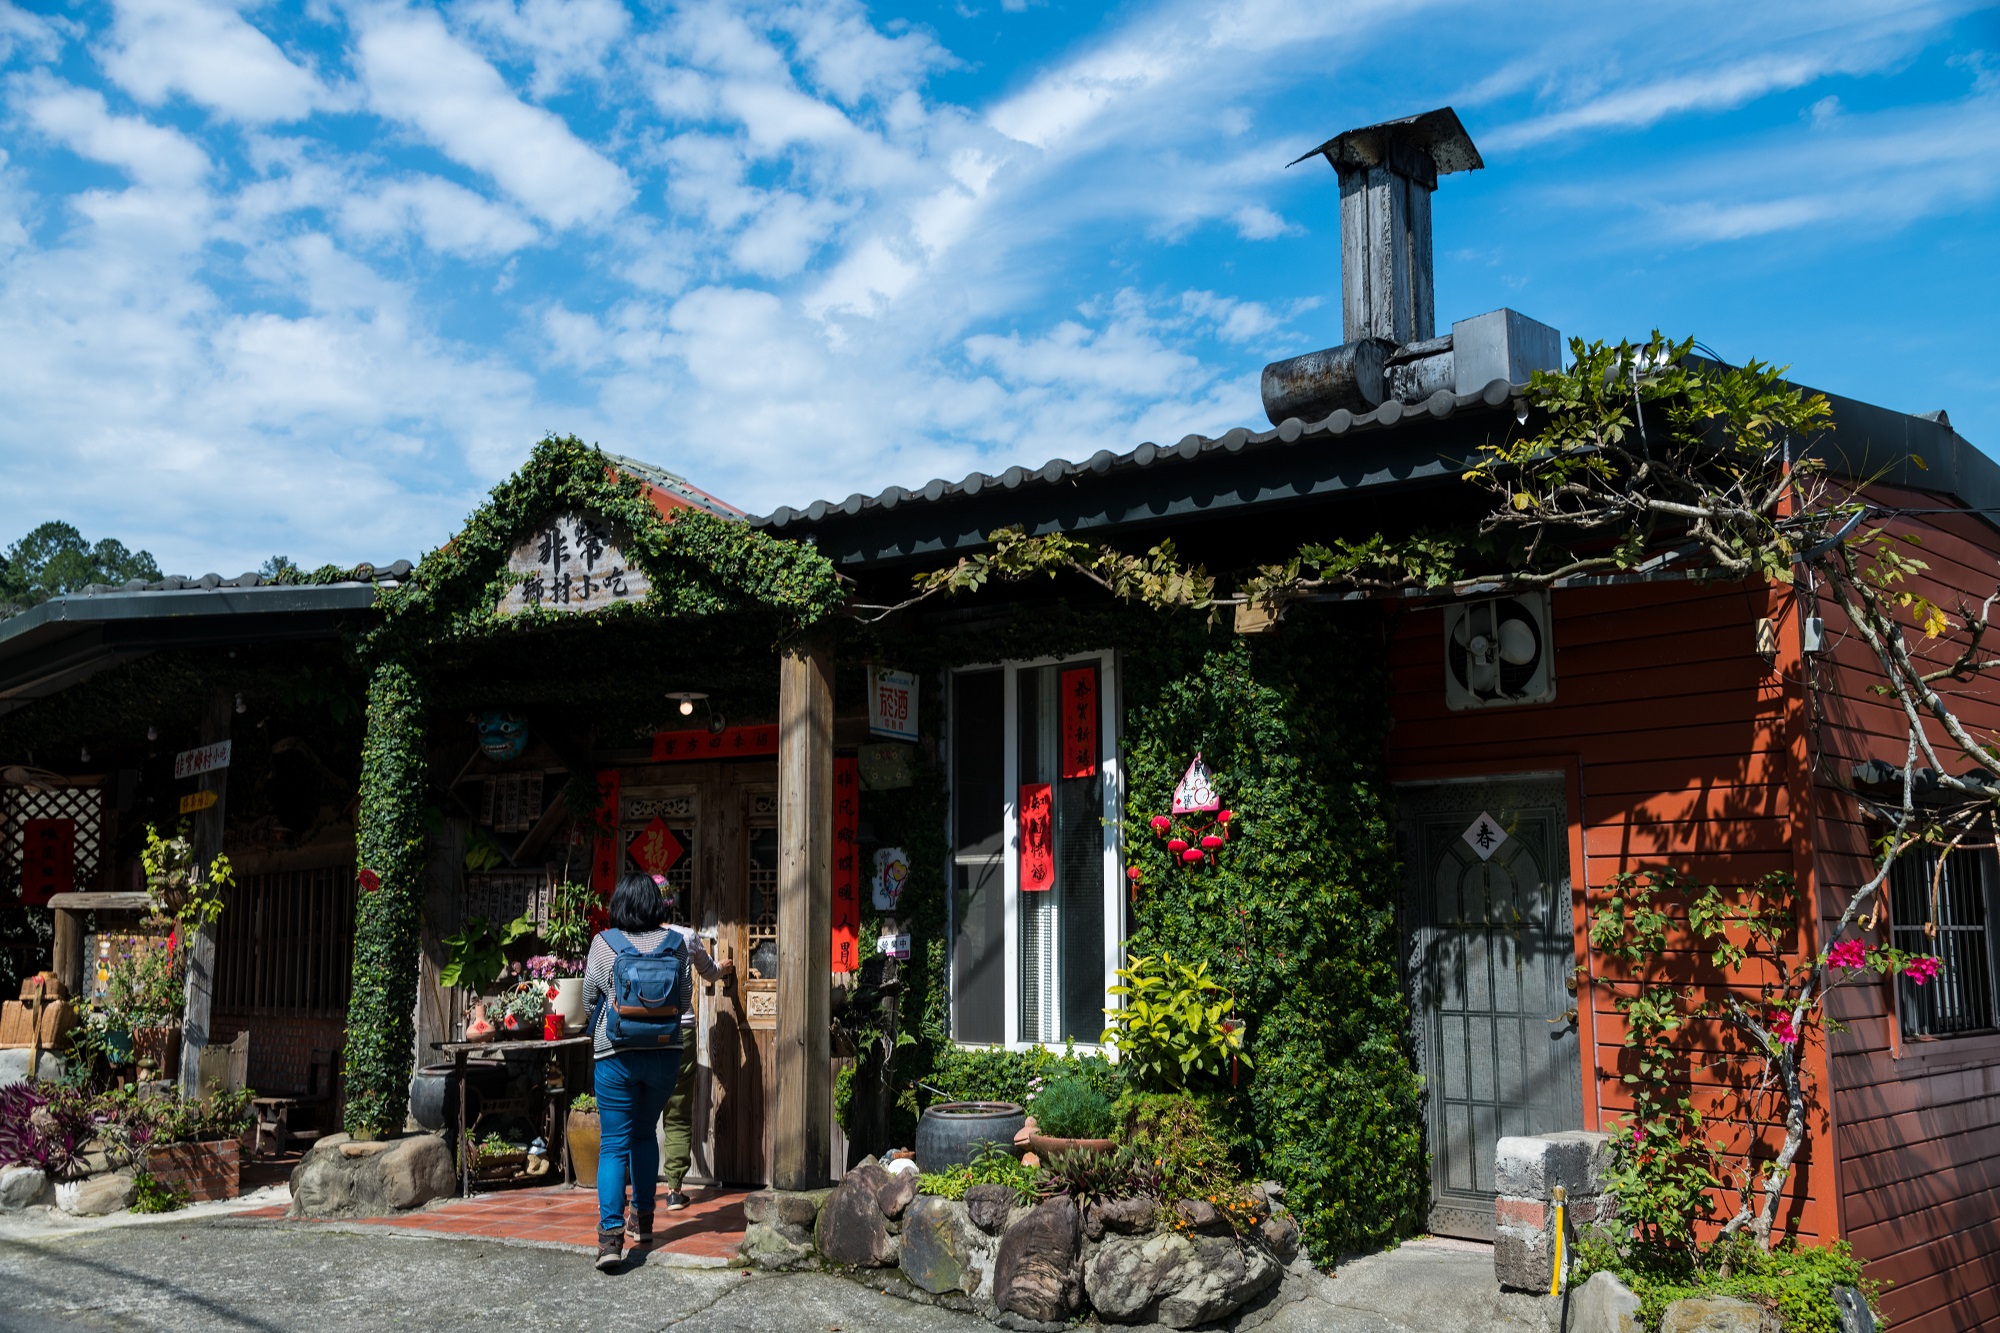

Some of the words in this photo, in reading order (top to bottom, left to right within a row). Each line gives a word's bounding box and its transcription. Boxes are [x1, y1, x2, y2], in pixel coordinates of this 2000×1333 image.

[538, 519, 607, 576] 非常
[522, 566, 629, 605] 鄉村小吃
[879, 686, 908, 721] 菸酒
[642, 828, 668, 867] 福
[1030, 791, 1046, 881] 知福惜福
[1476, 821, 1497, 850] 春
